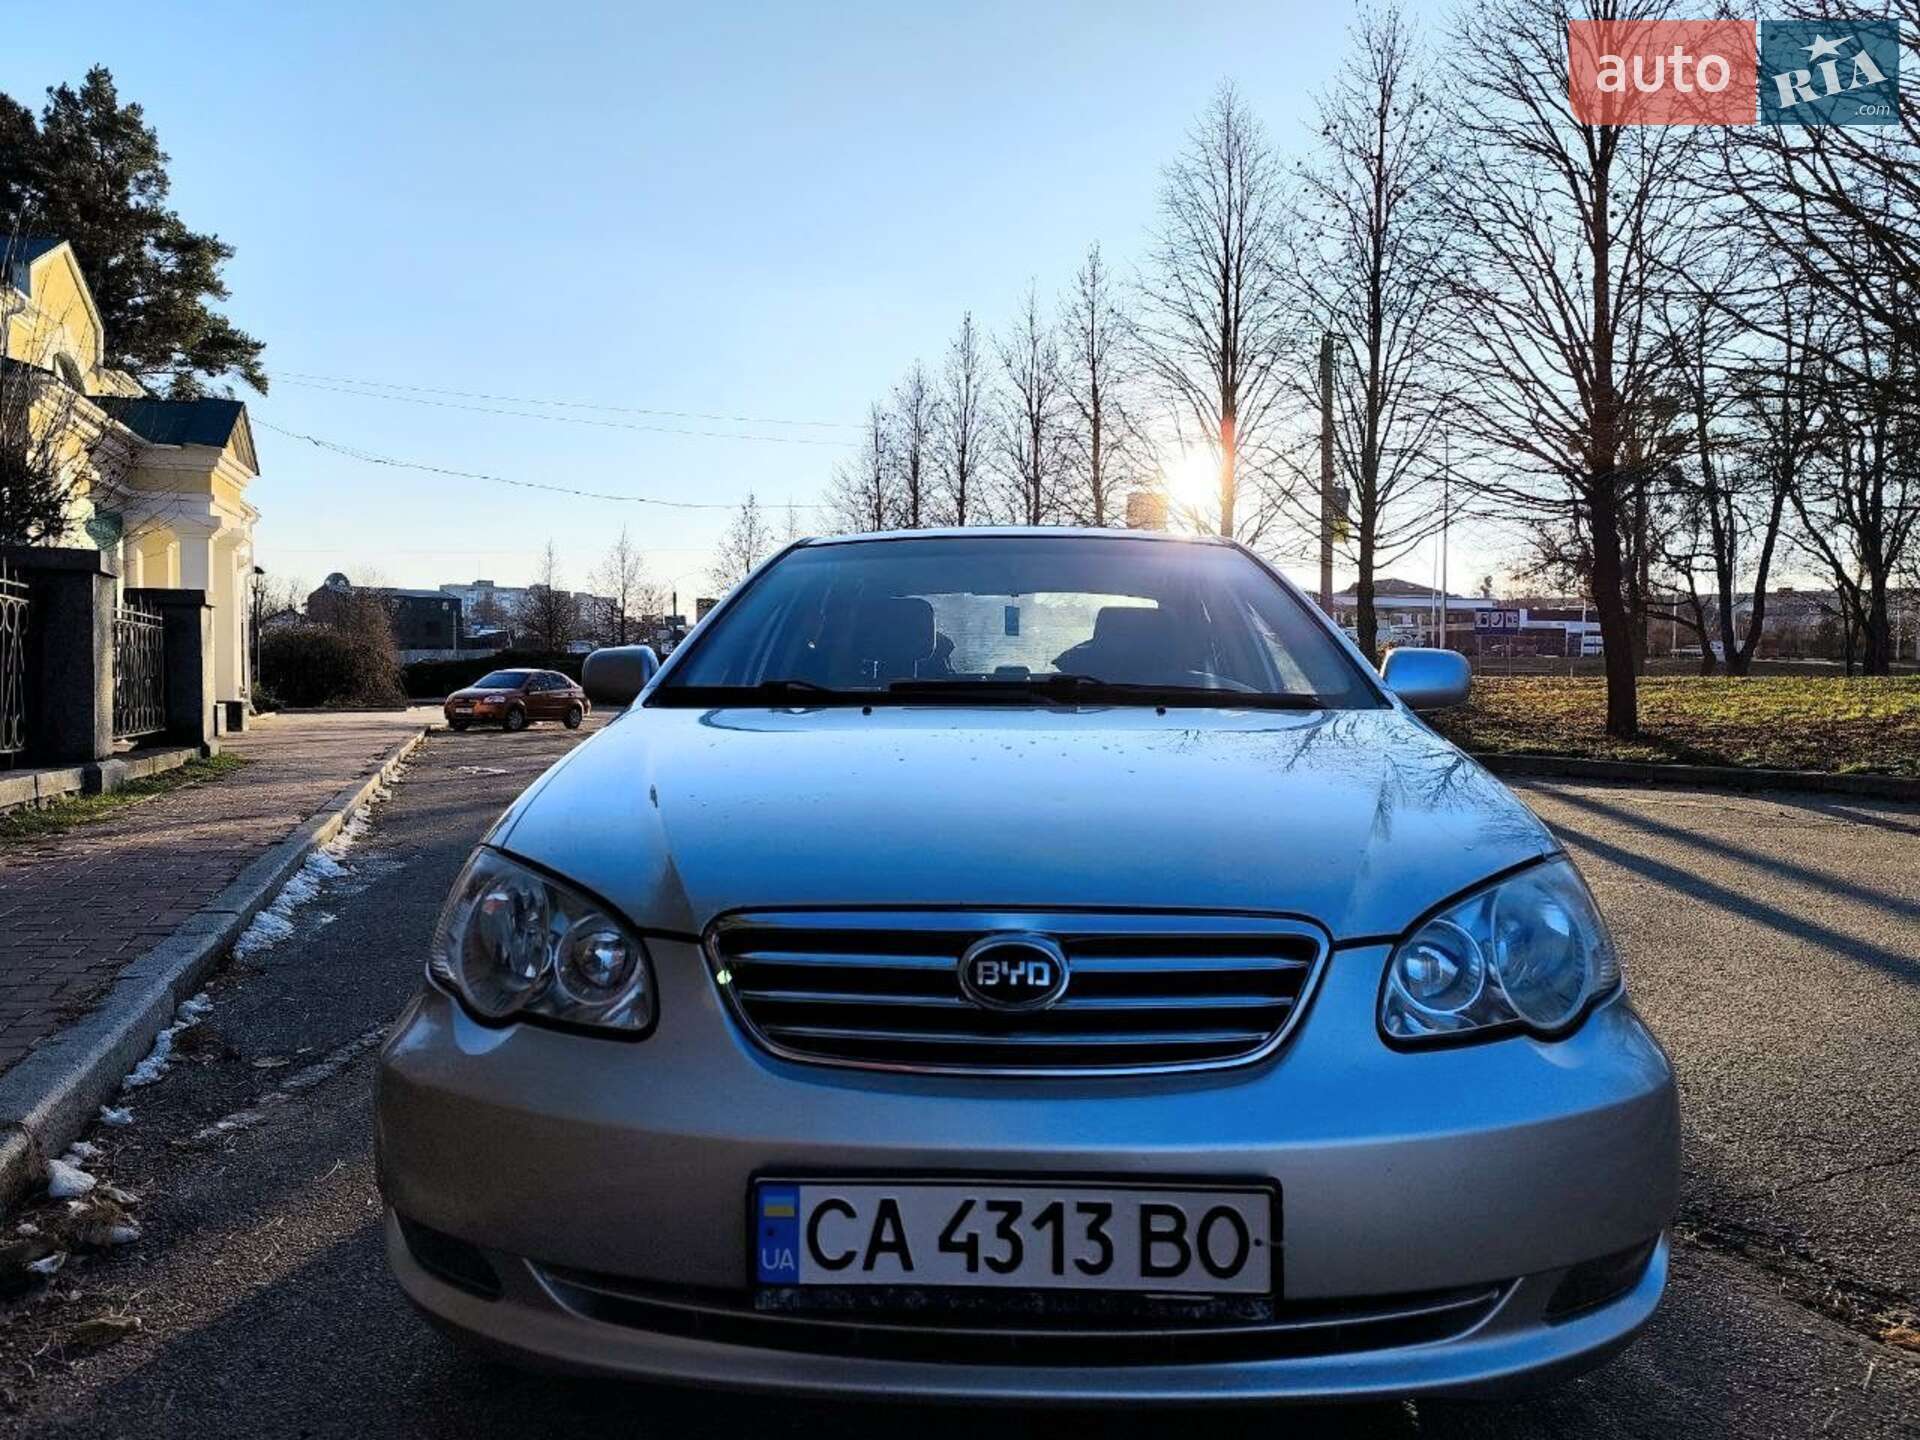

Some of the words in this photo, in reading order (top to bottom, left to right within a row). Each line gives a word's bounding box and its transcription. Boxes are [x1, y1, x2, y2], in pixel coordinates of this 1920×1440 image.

[977, 960, 1051, 986] BYD
[806, 1197, 914, 1272] CA
[937, 1199, 1114, 1276] 4313
[1140, 1203, 1250, 1280] BO
[761, 1247, 794, 1271] UA
